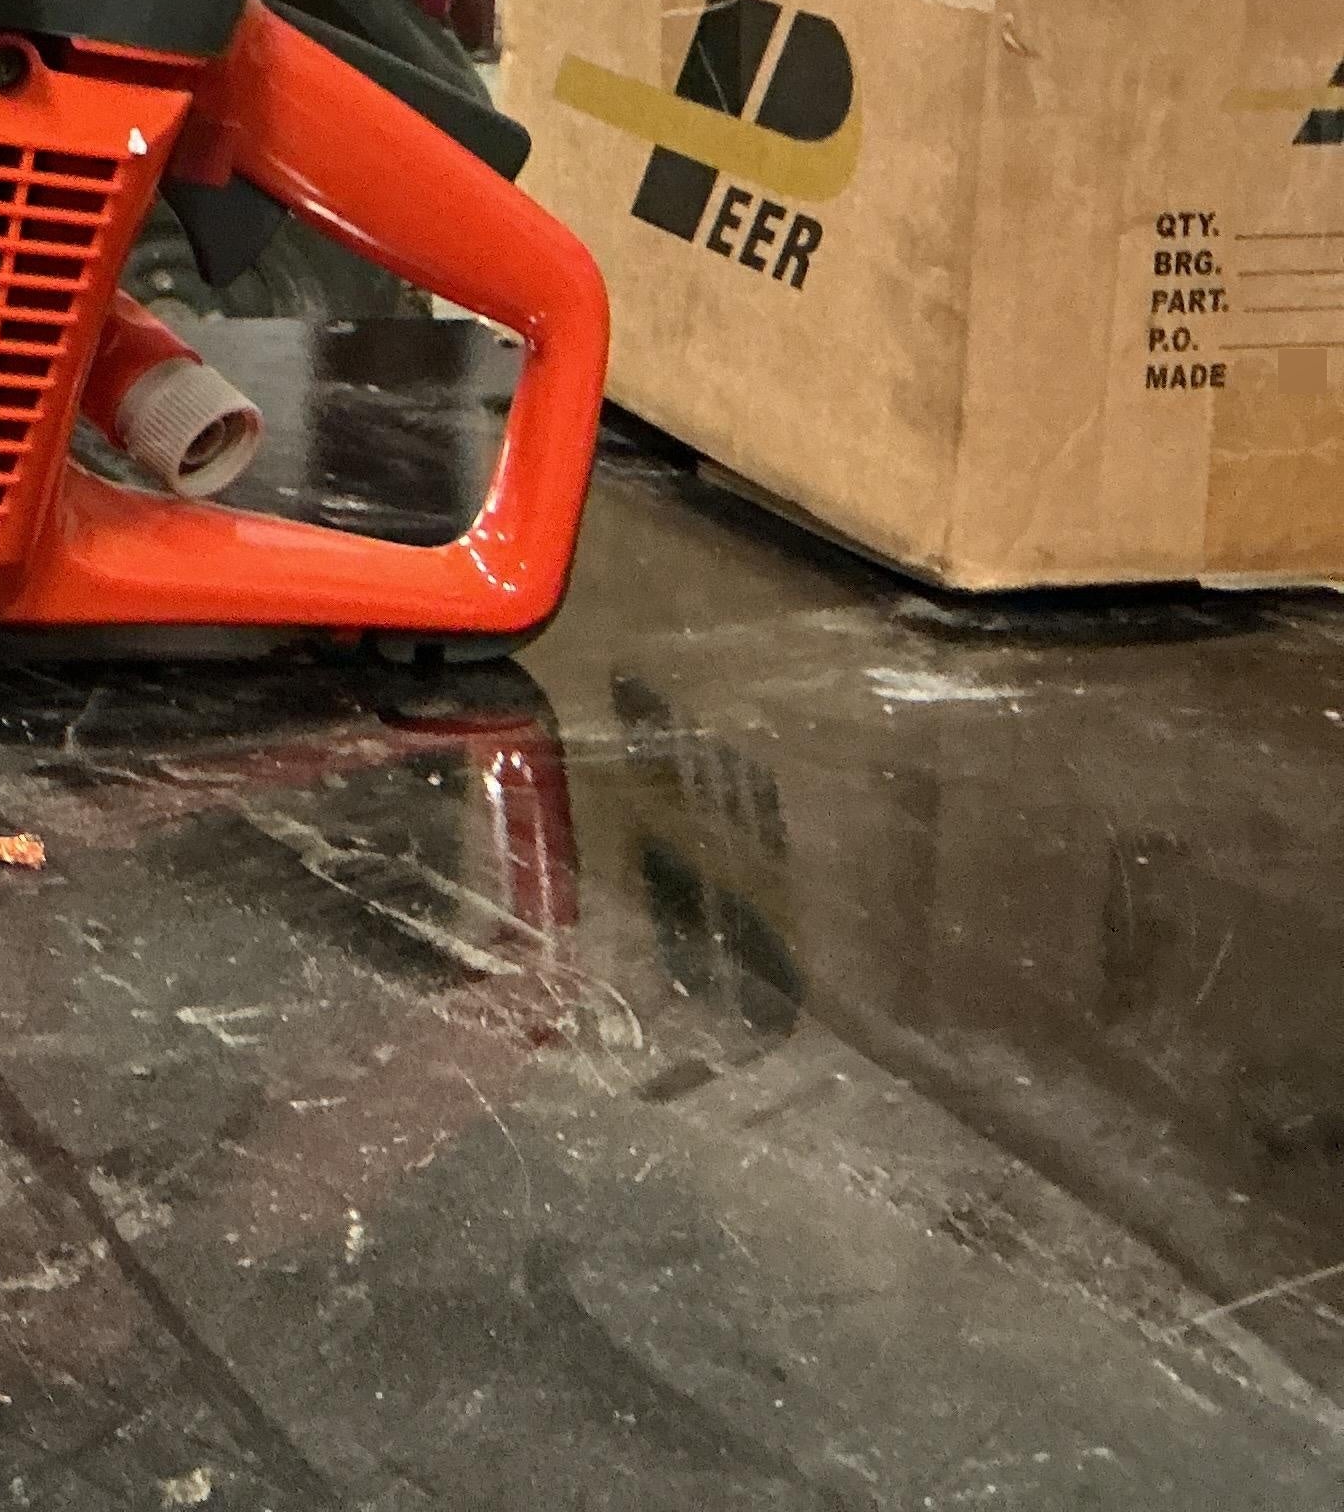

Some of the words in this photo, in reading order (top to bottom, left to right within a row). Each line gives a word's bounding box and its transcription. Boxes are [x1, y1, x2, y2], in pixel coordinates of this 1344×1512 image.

[1155, 211, 1220, 238] QTY.
[1153, 250, 1222, 277] BRG.
[1150, 288, 1229, 314] PART.
[1148, 326, 1199, 353] P.O.
[1145, 362, 1227, 390] MADE
